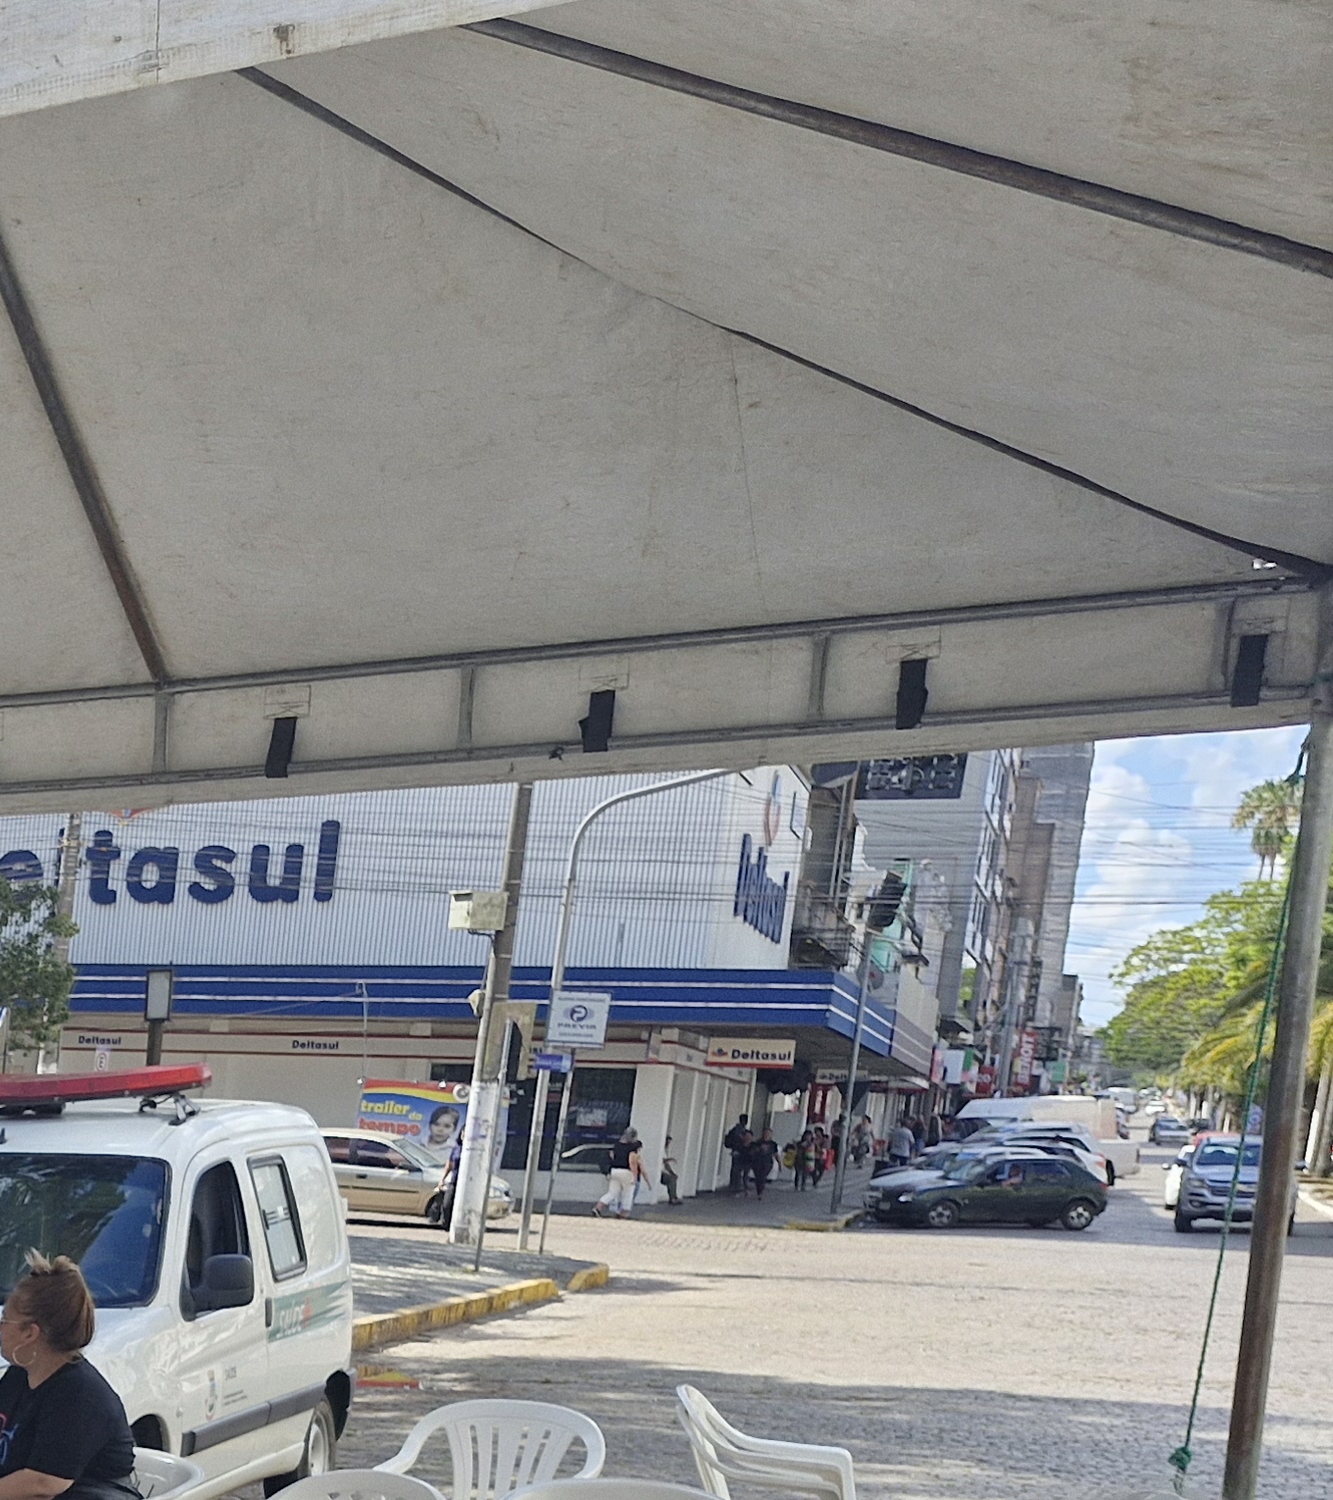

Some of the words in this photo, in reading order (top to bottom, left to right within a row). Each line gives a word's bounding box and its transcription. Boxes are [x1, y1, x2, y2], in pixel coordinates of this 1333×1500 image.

[78, 1035, 121, 1045] Deltasul
[292, 1040, 339, 1050] Deltasul
[731, 1049, 792, 1062] Deltasul
[360, 1100, 411, 1115] trailer
[359, 1118, 421, 1136] tempo
